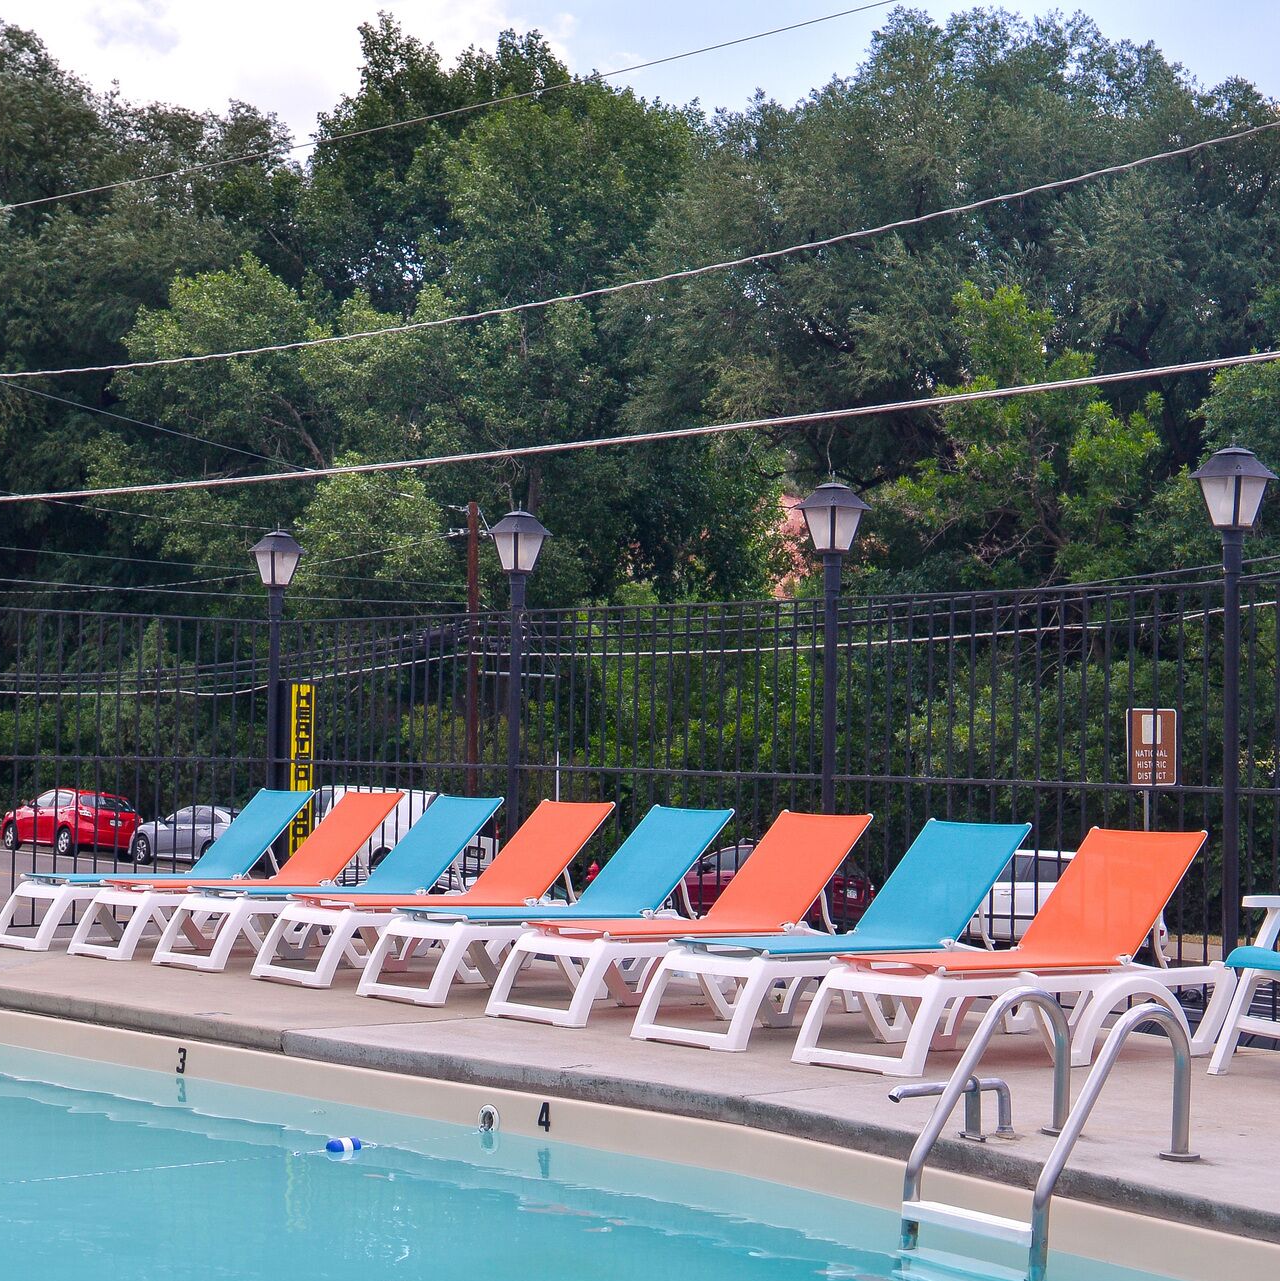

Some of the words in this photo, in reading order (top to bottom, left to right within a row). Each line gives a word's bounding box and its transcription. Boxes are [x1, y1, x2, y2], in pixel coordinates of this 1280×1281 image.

[1136, 760, 1167, 769] HISTRIC
[1137, 771, 1167, 780] DISTICT
[176, 1047, 187, 1074] 3
[537, 1101, 551, 1132] 4
